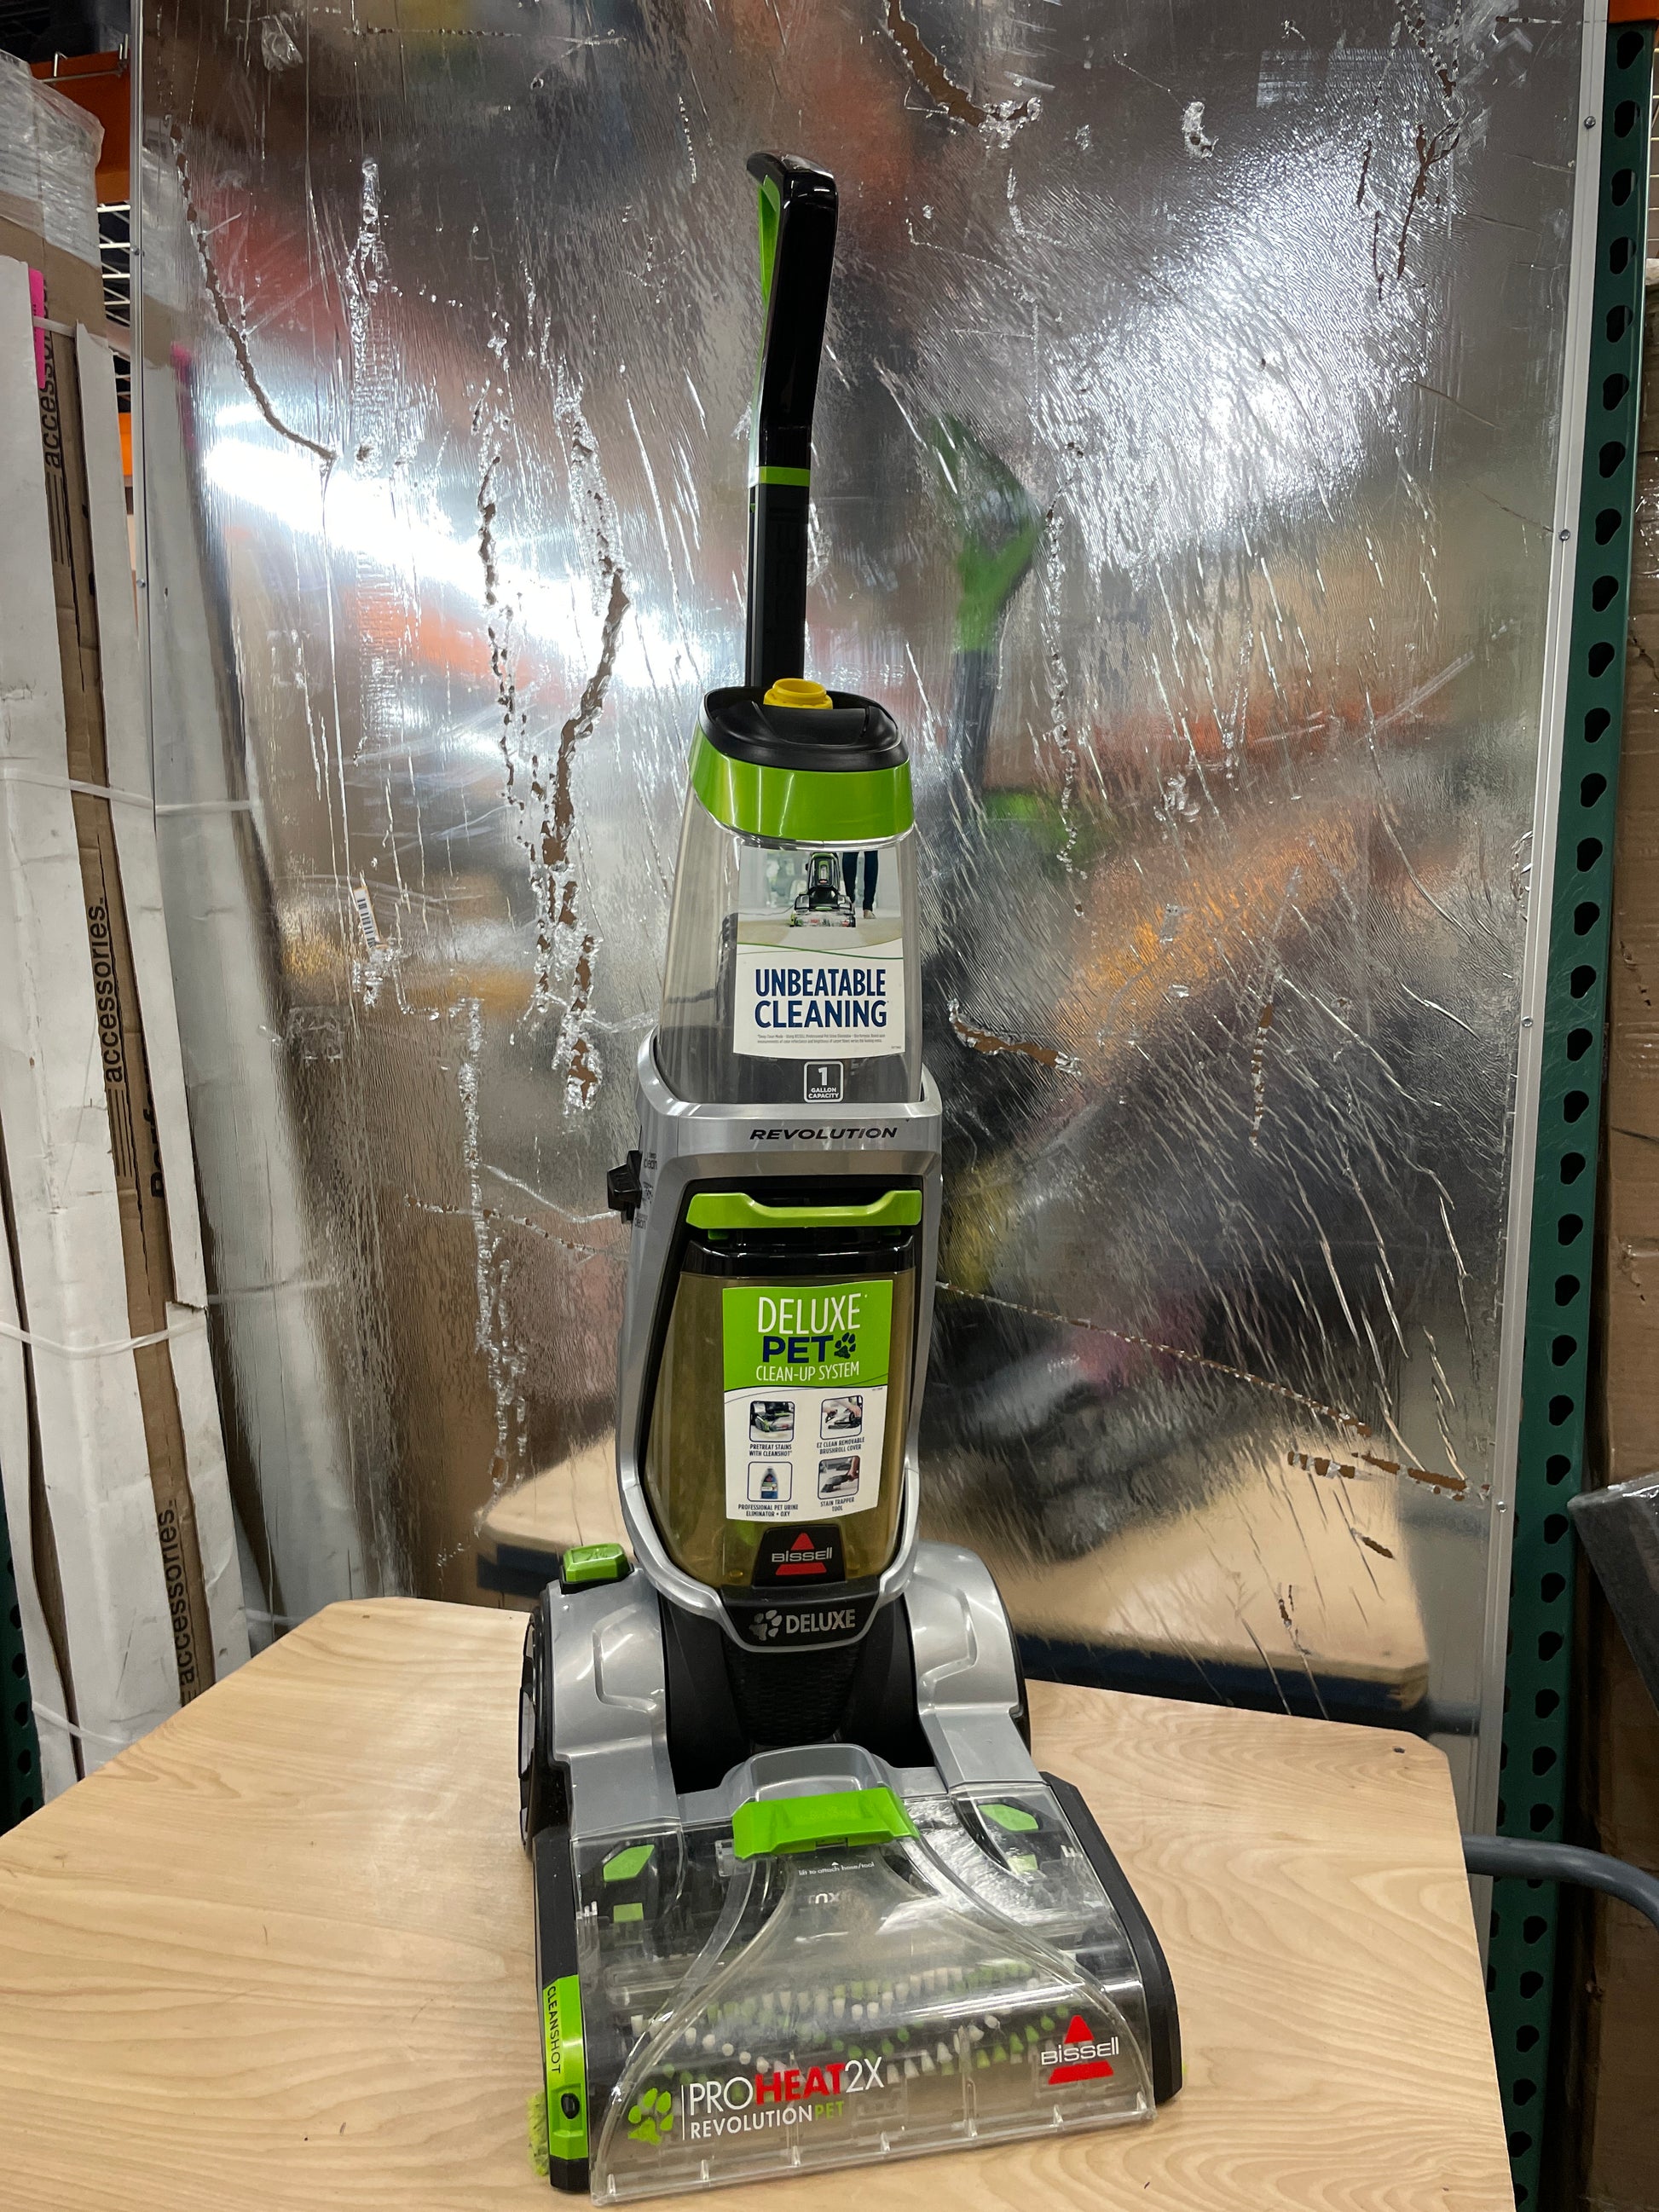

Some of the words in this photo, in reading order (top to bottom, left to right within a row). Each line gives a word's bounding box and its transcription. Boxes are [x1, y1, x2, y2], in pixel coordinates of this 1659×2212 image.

[755, 968, 886, 996] UNBEATABLE
[754, 1000, 887, 1028] CLEANING
[818, 1066, 828, 1086] 1
[749, 1127, 898, 1140] REVOLUTION
[758, 1292, 862, 1334] DELUXE
[762, 1334, 834, 1364] PET
[756, 1366, 816, 1382] CLEAN-UP
[818, 1360, 859, 1380] SYSTEM
[819, 1446, 847, 1454] BRUSHROLL
[838, 1436, 865, 1445] REMOVABLE
[785, 1608, 856, 1634] DELUXE
[841, 1861, 875, 1870] hose/tool
[546, 1985, 561, 2074] CLEANSHOT
